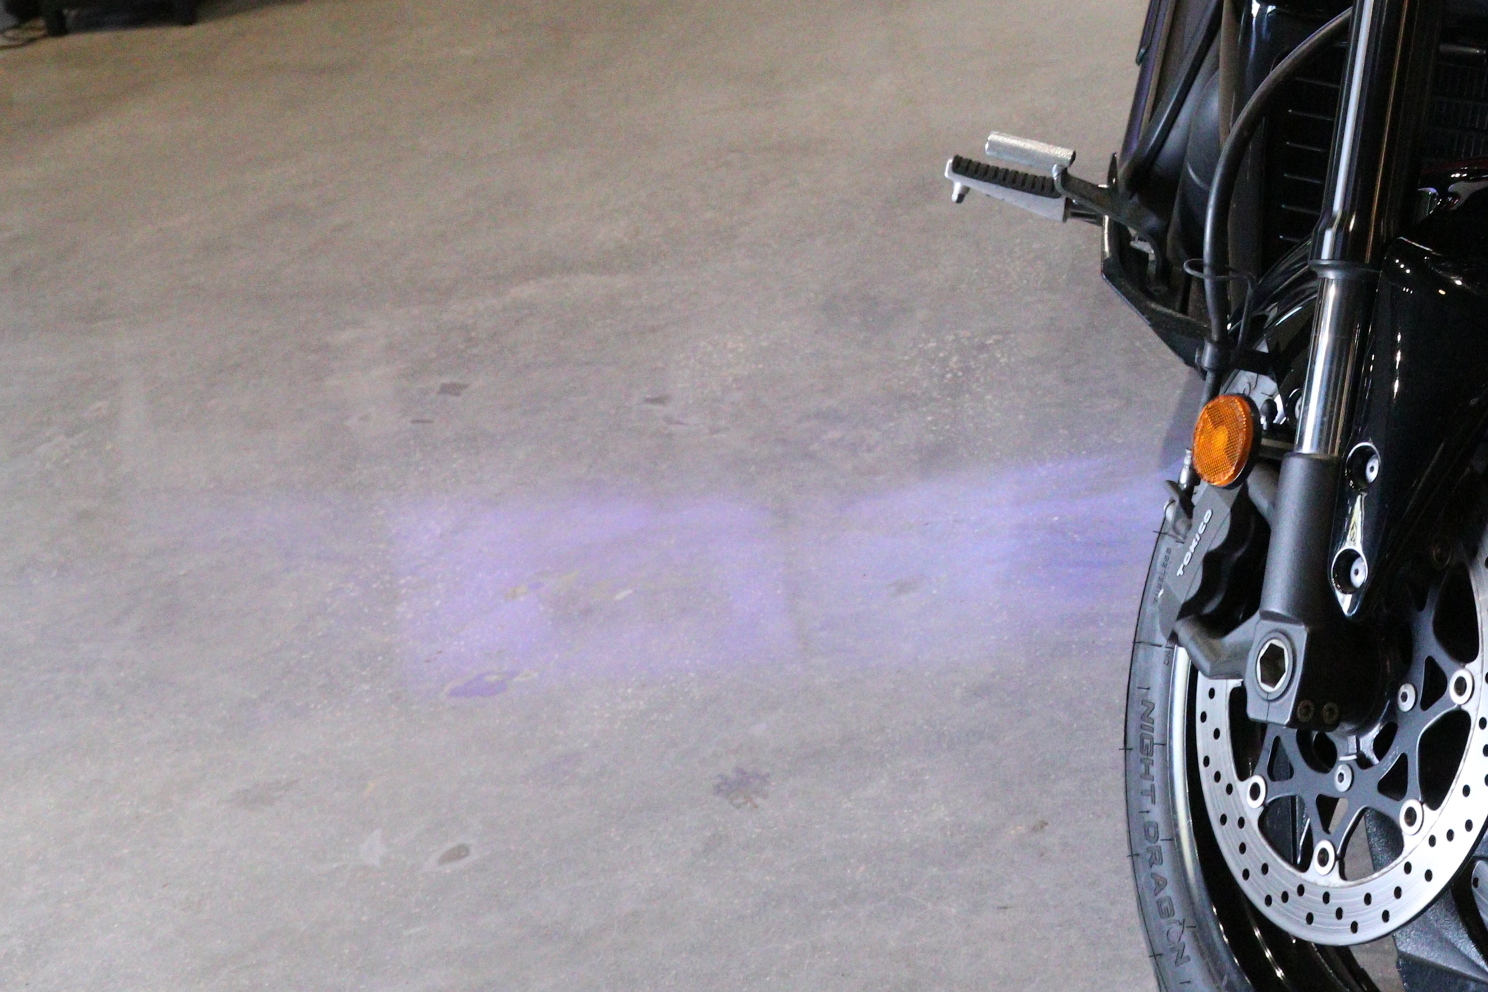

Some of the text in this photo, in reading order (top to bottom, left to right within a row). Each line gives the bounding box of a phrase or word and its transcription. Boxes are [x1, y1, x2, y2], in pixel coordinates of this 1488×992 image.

[1176, 508, 1214, 577] TOKICO
[1138, 698, 1191, 968] NIGHT DRAGON
